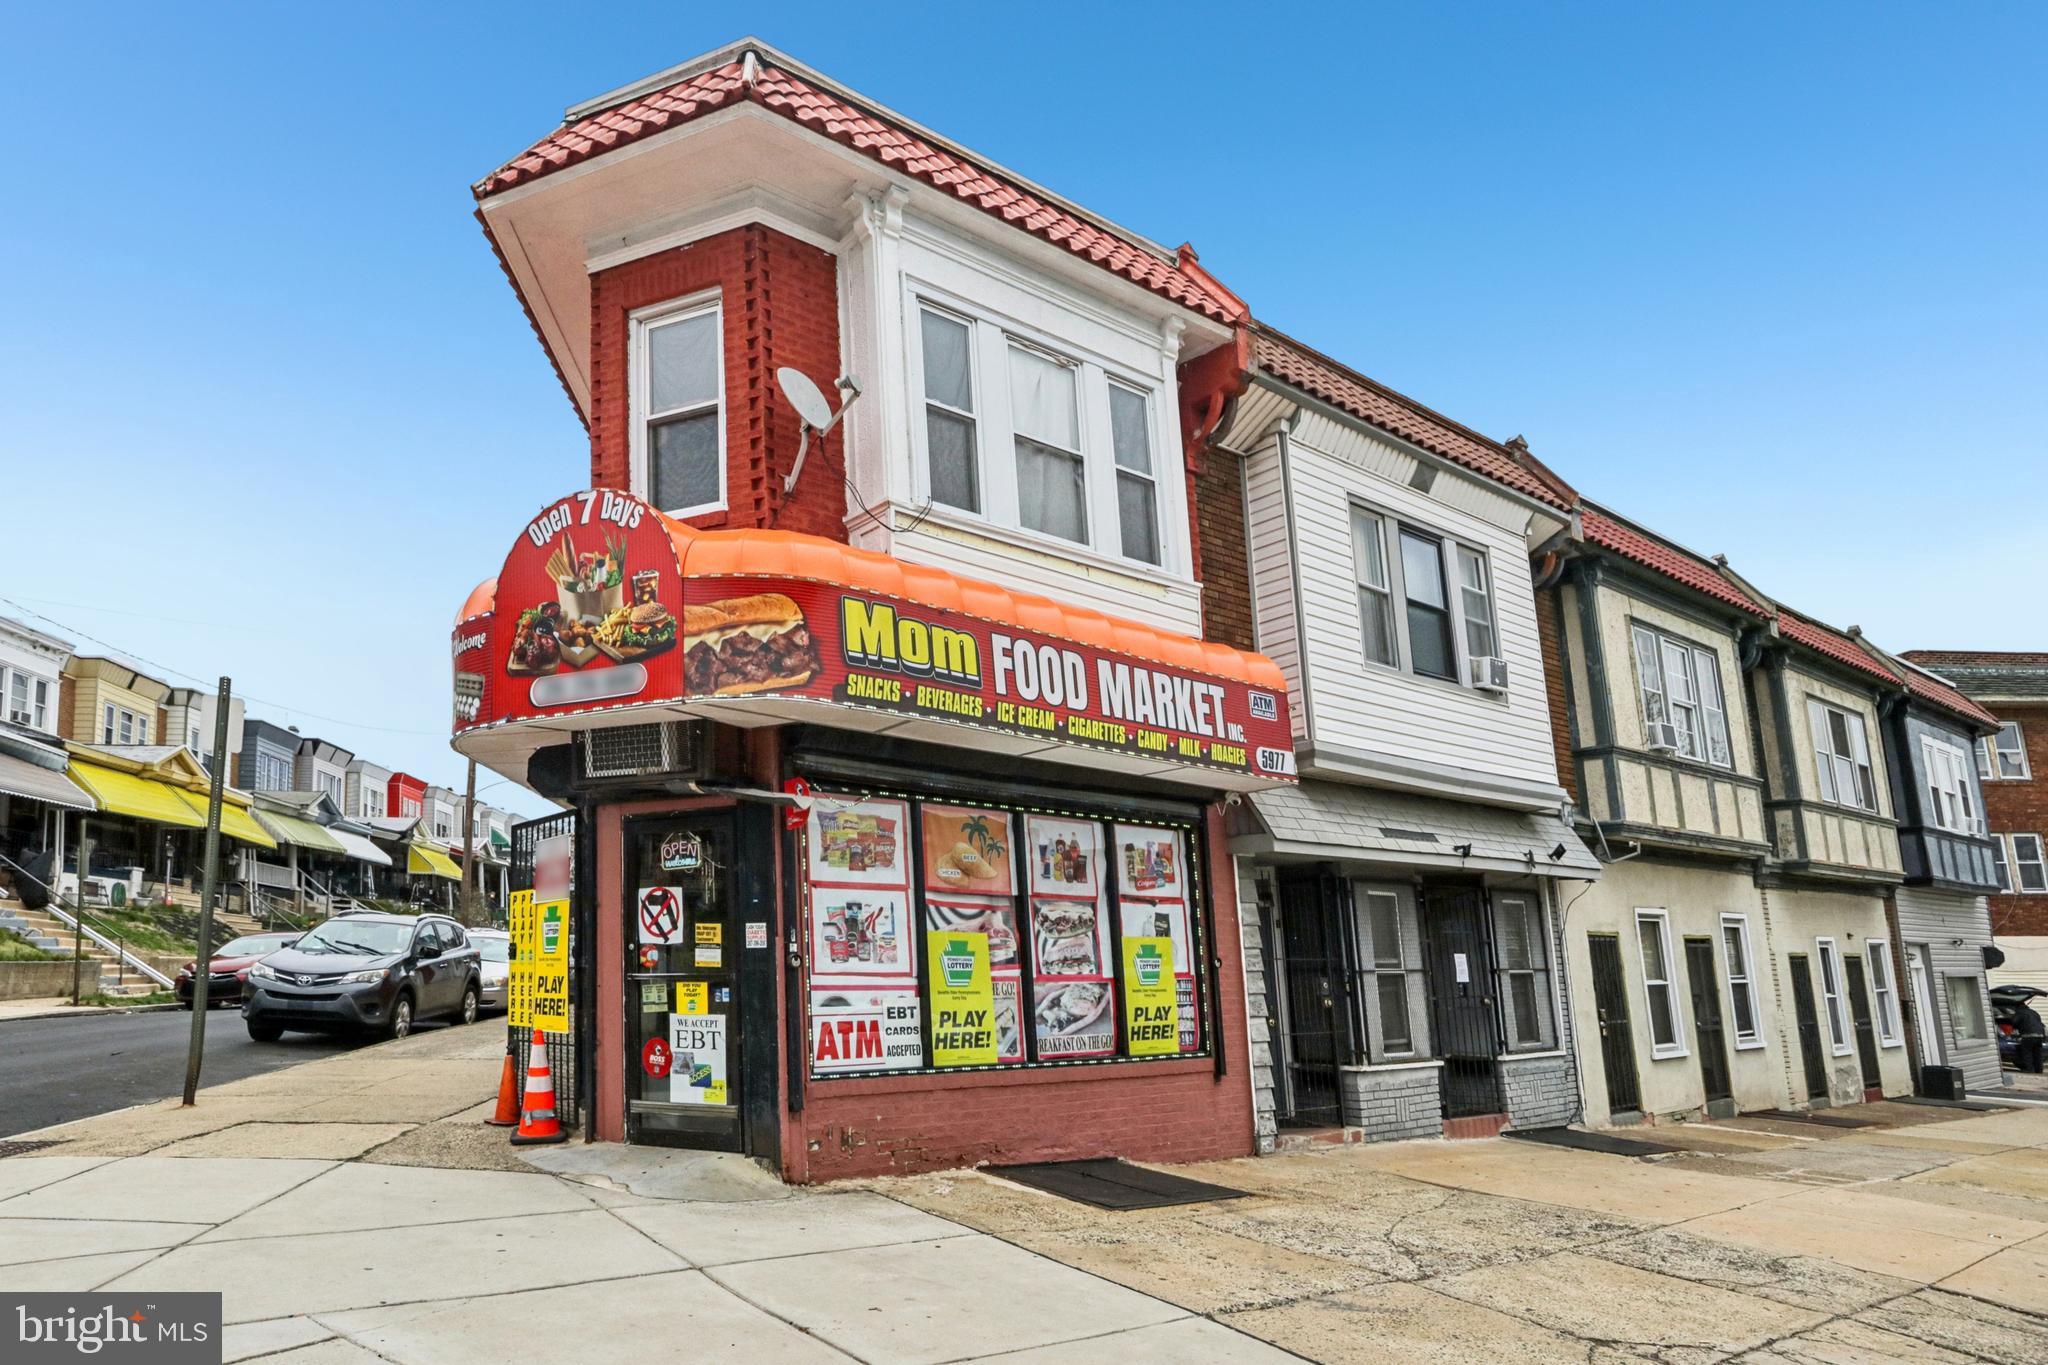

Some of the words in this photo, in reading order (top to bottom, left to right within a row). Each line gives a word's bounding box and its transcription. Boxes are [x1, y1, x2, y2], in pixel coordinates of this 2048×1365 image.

[528, 503, 572, 547] Open
[577, 490, 597, 525] 7
[600, 492, 645, 529] Days
[843, 596, 981, 687] Mom
[991, 633, 1089, 711] FOOD
[1097, 658, 1225, 739] MARKET
[1227, 722, 1248, 743] INC.
[1252, 695, 1274, 711] ATM
[847, 673, 901, 702] SNACKS
[917, 685, 983, 718] BEVERAGES
[997, 701, 1015, 724] ICE
[1018, 705, 1055, 731] CREAM
[1068, 715, 1126, 744] CIGARETTES
[1137, 729, 1168, 752] CANDY
[1179, 737, 1200, 758] MILK
[1211, 743, 1246, 766] HOAGIES
[1262, 750, 1285, 771] 5977
[663, 841, 697, 858] OPEN
[665, 855, 696, 867] welcome
[537, 975, 565, 994] PLAY
[1001, 982, 1015, 996] GO!
[534, 997, 566, 1017] HERE!
[886, 1006, 917, 1020] EBT
[1133, 1006, 1171, 1022] PLAY
[677, 1019, 689, 1028] WE
[691, 1019, 719, 1028] ACCEPT
[939, 1010, 987, 1029] PLAY
[675, 1029, 721, 1050] EBT
[816, 1020, 884, 1061] ATM
[885, 1026, 920, 1036] CARDS
[934, 1031, 992, 1050] HERE!
[1130, 1024, 1175, 1041] HERE!
[886, 1044, 921, 1057] ACCEPTED
[1038, 1036, 1075, 1053] REAKFAST
[1076, 1036, 1086, 1051] ON
[1087, 1035, 1100, 1050] THE
[1101, 1034, 1114, 1049] GO!
[649, 1055, 665, 1063] BOSS
